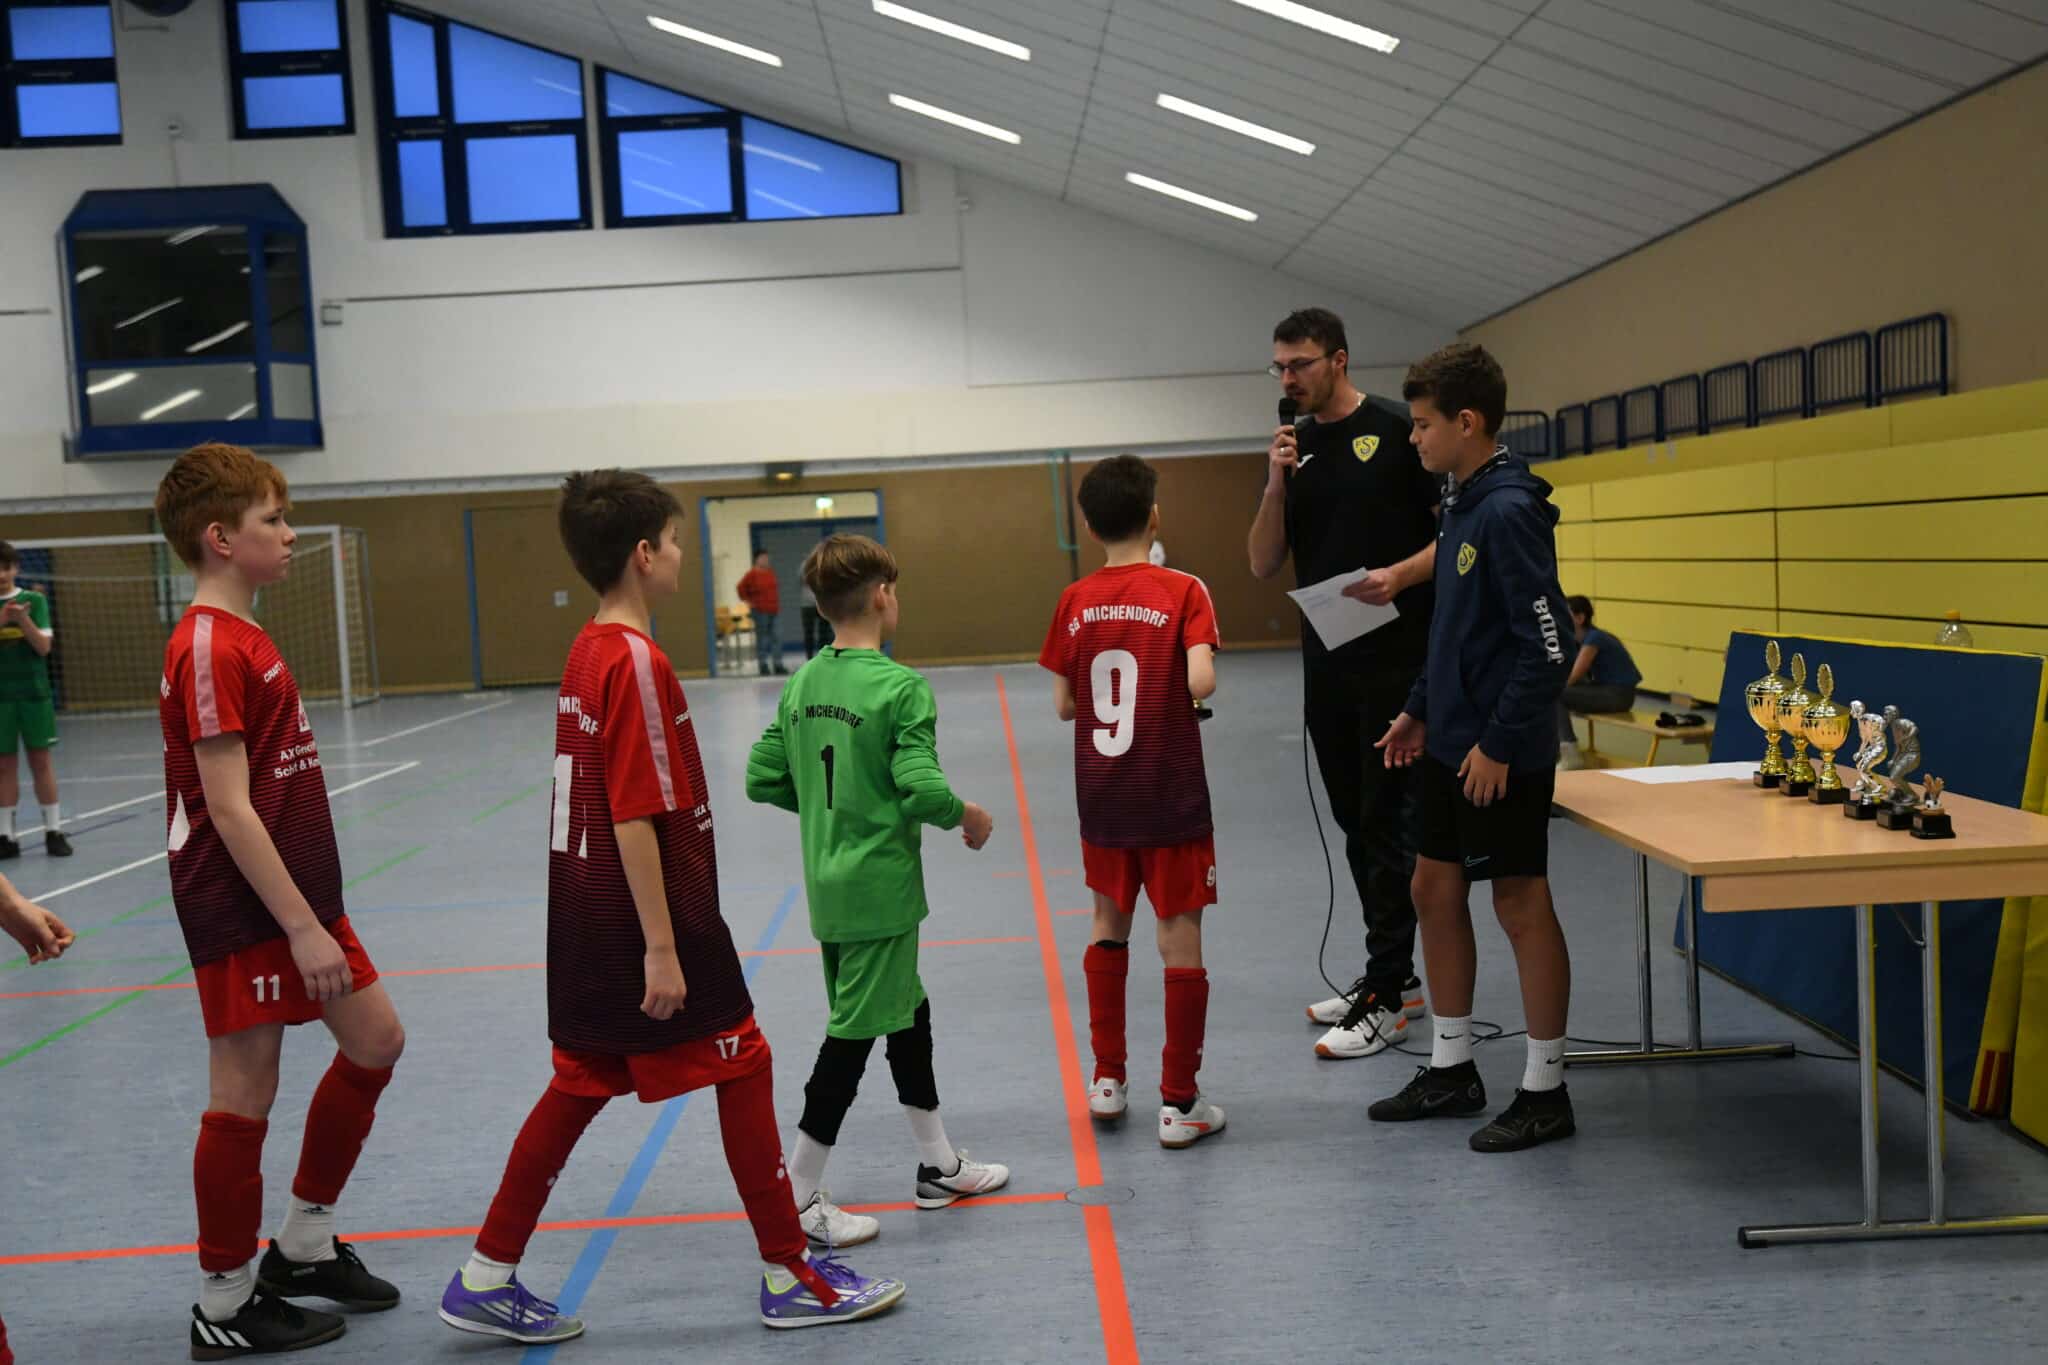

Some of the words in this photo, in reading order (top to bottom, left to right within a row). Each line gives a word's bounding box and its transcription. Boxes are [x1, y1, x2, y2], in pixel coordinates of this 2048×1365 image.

[1068, 617, 1081, 637] SG
[1082, 605, 1169, 628] MICHENDORF
[805, 704, 865, 729] MICHENDORF
[1090, 649, 1139, 758] 9
[820, 744, 834, 810] 1
[1206, 864, 1216, 888] 9
[252, 974, 280, 1003] 11
[715, 1034, 740, 1060] 17
